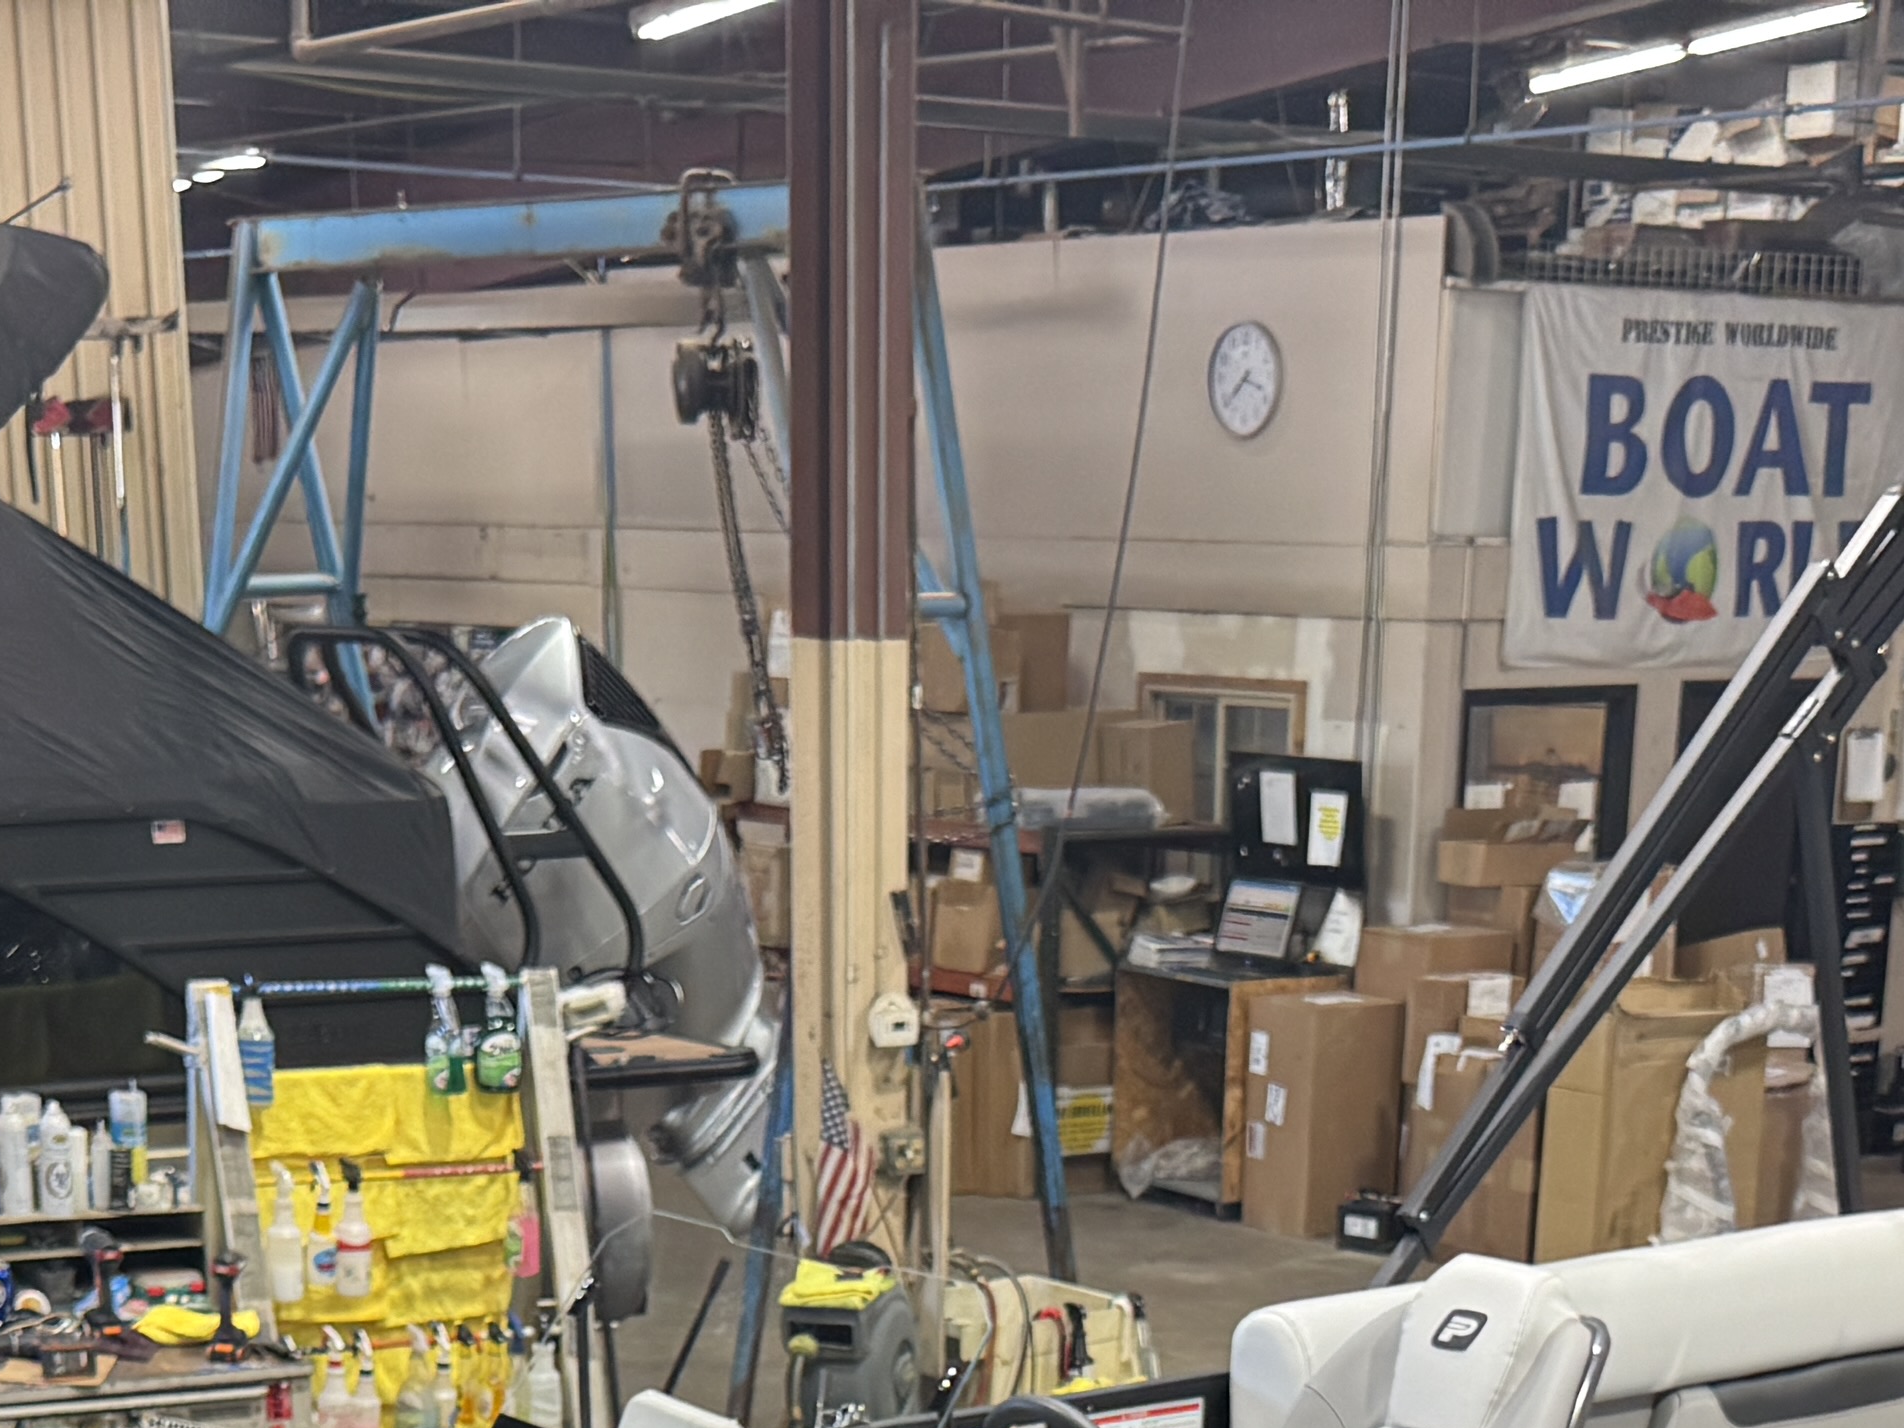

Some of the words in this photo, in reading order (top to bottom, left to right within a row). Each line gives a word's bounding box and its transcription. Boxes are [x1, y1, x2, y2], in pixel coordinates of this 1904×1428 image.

[1620, 317, 1715, 346] PRESTIGE
[1724, 322, 1838, 350] WORLDWIDE
[1580, 374, 1872, 498] BOAT
